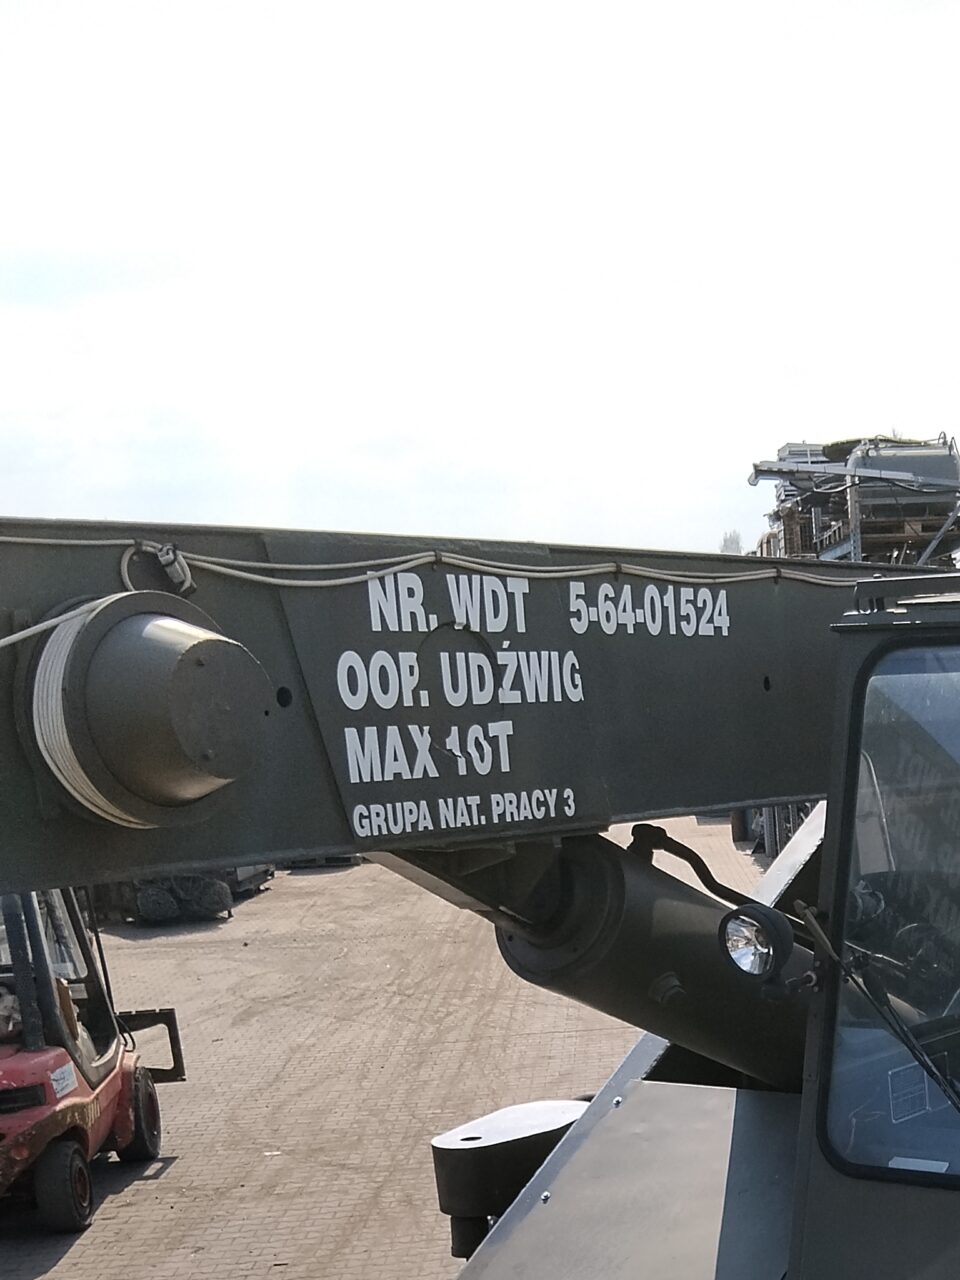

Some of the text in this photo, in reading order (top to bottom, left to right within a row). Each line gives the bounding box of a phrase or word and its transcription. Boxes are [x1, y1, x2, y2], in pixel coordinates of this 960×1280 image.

[367, 571, 730, 636] NR. WDT 5-64-01524
[337, 640, 584, 710] OOP. UDŹWIG
[344, 724, 439, 783] MAX
[353, 788, 576, 837] GRUPA NAT. PRACY 3
